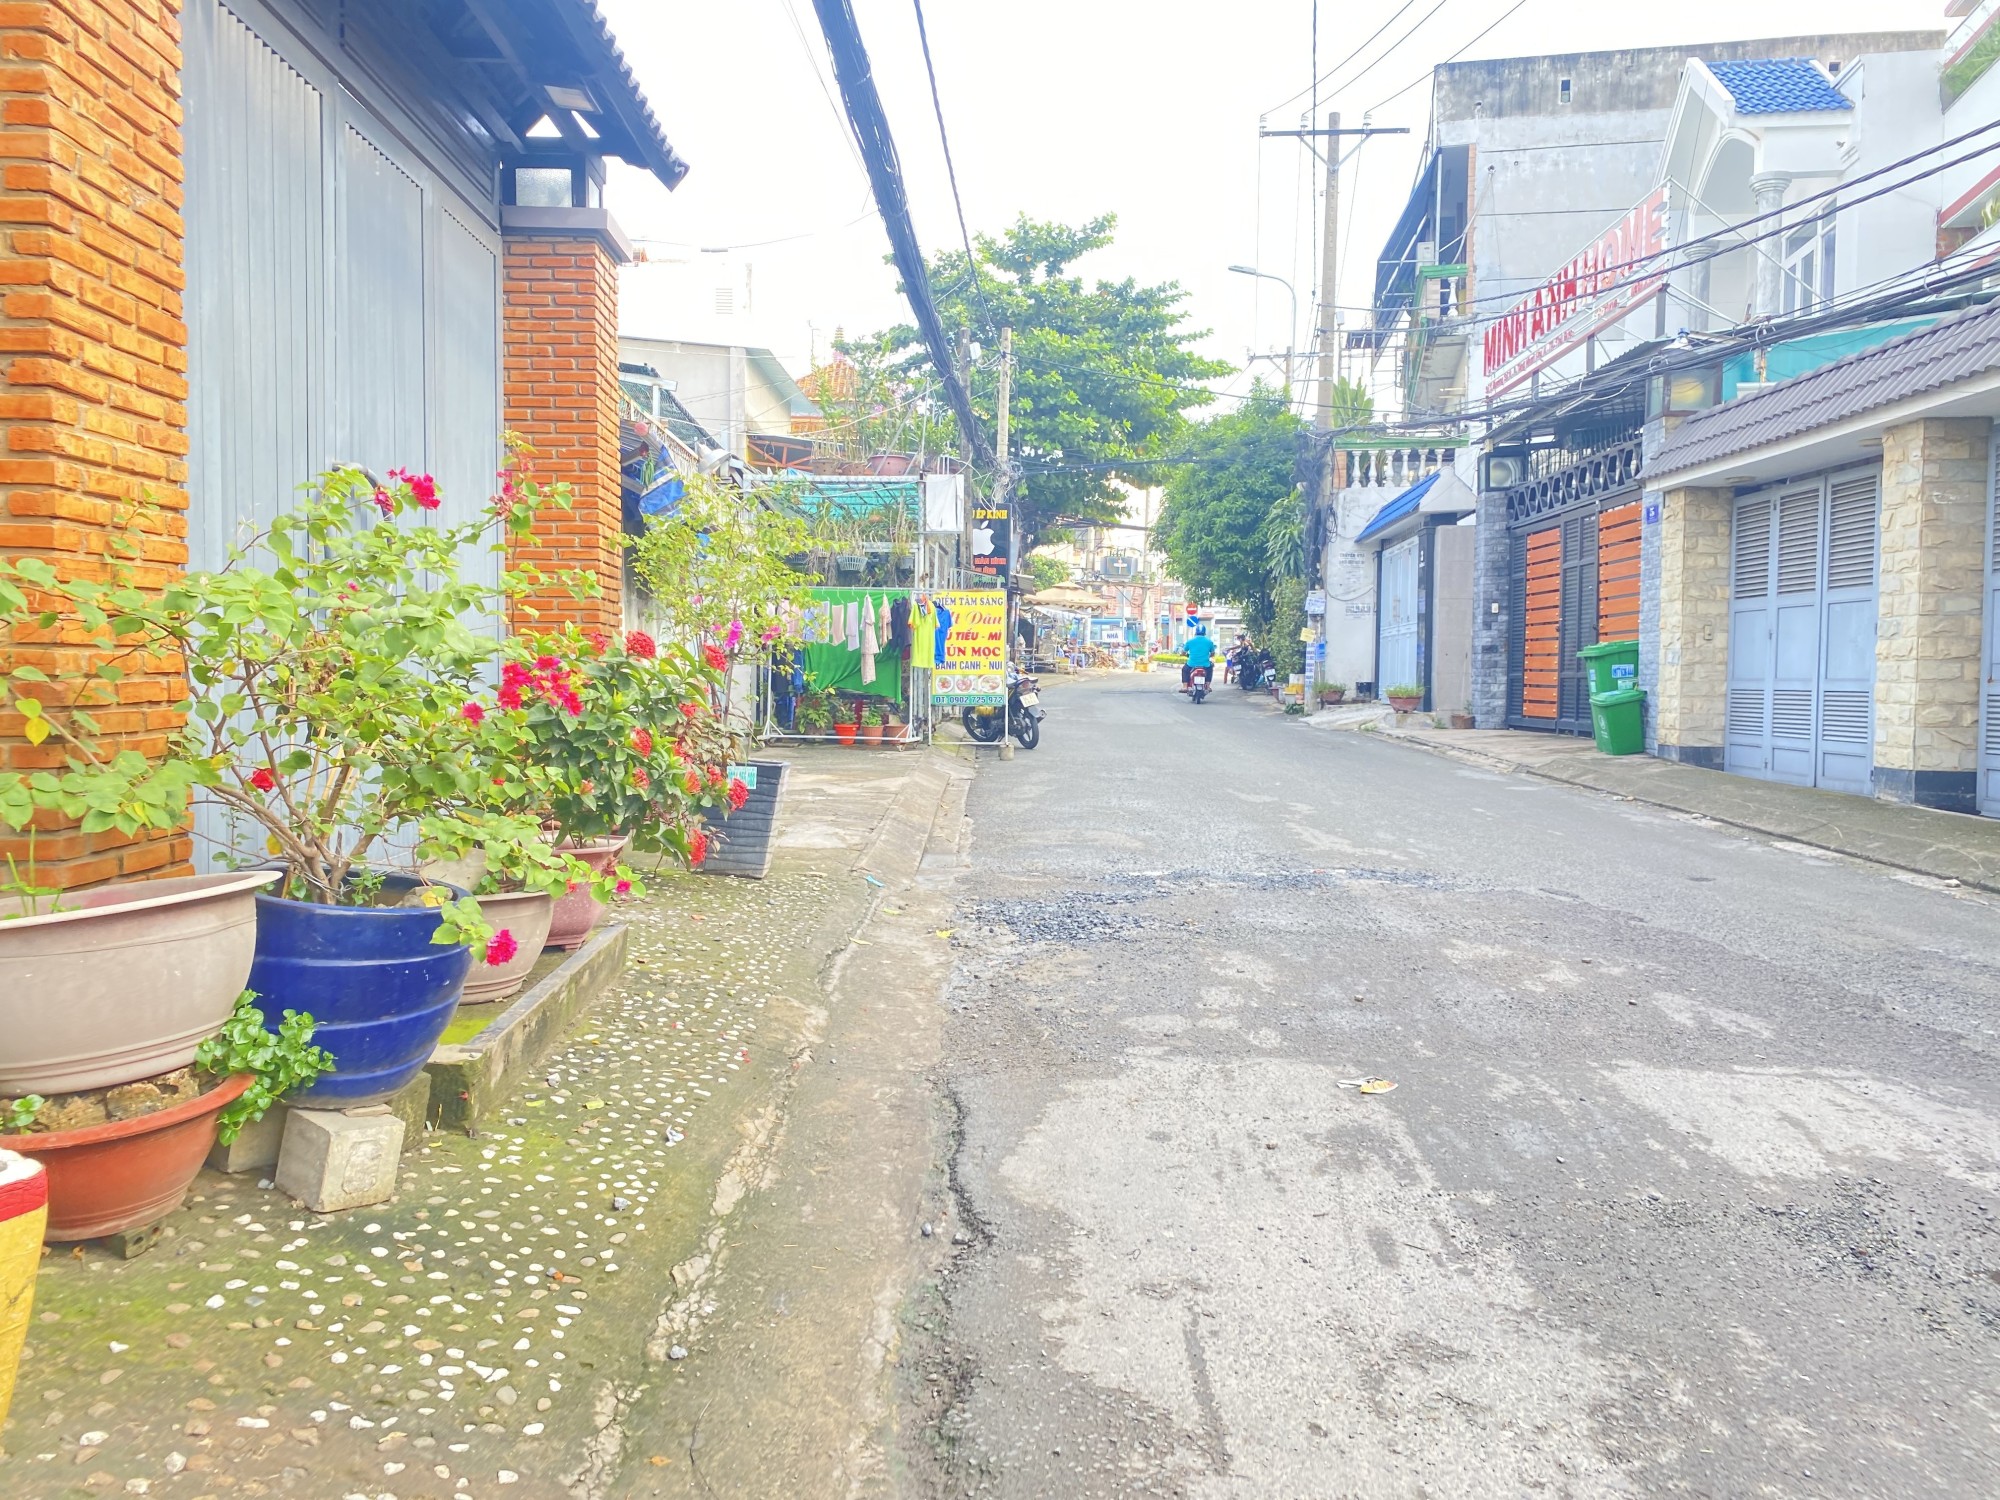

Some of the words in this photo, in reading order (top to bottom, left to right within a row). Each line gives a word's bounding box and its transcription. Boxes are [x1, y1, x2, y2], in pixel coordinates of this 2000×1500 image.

[1483, 299, 1528, 377] MINH
[1531, 257, 1578, 342] ANH
[1581, 187, 1665, 306] HOME
[959, 595, 977, 606] TÂM
[980, 594, 1004, 606] SÁNG
[955, 628, 979, 641] TIẾU
[946, 643, 967, 657] ÚN
[971, 646, 1001, 660] MỌC
[989, 661, 1003, 670] NUI
